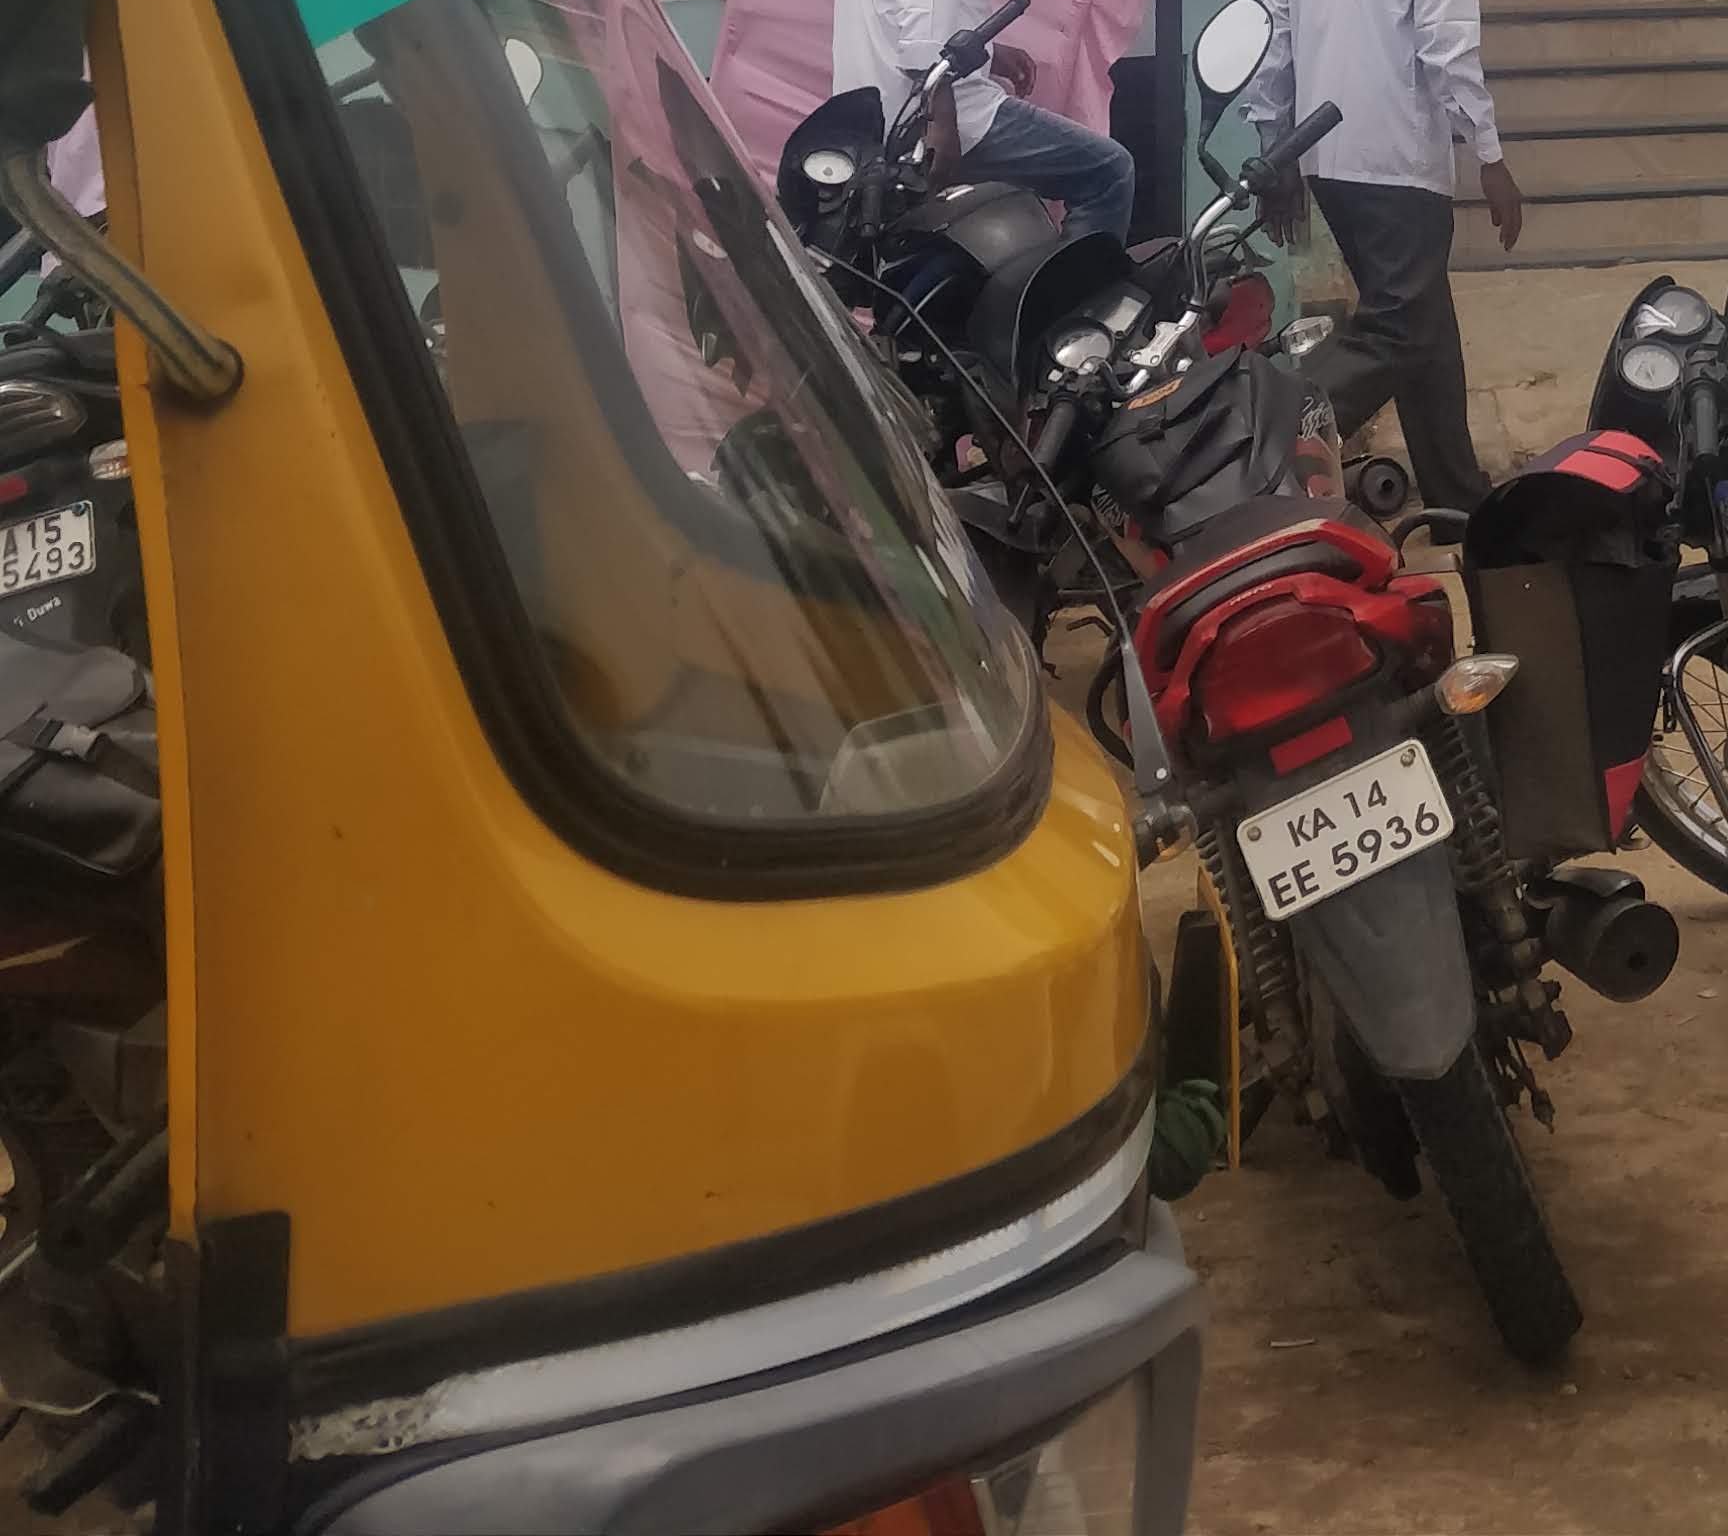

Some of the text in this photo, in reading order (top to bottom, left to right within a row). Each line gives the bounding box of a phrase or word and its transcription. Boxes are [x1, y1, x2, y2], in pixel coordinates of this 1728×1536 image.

[1268, 802, 1440, 910] EE 5936
[1286, 780, 1387, 847] KA 14
